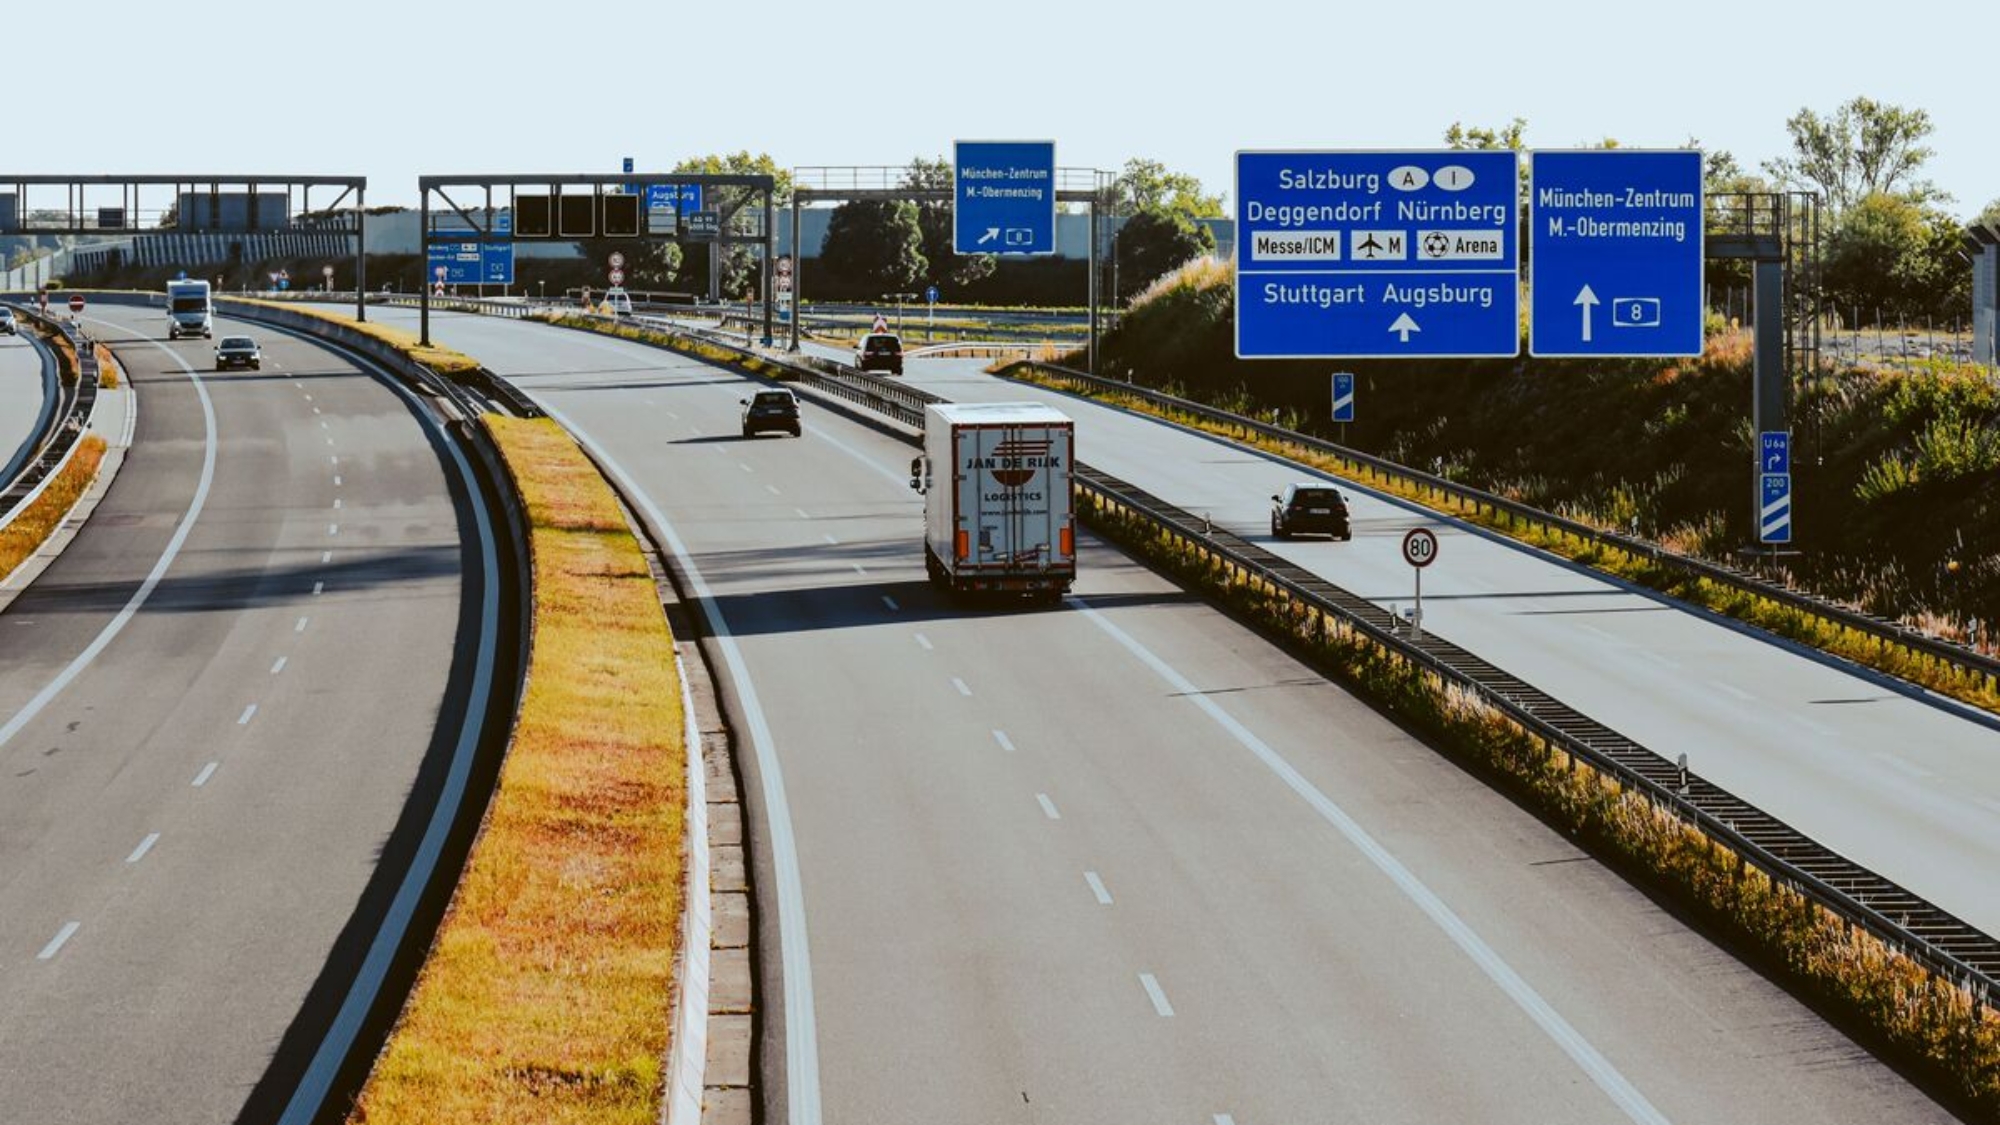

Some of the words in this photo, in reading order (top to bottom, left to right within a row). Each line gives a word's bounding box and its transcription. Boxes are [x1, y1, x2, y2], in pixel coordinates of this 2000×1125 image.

[961, 167, 1048, 179] München-Zentrum
[1279, 169, 1380, 194] Salzburg
[1402, 171, 1415, 186] A
[1451, 171, 1456, 186] I
[1539, 187, 1694, 208] München-Zentrum
[1247, 201, 1382, 226] Deggendorf
[1397, 200, 1506, 226] Nürnberg
[1548, 216, 1686, 242] M.-Obermenzing
[1257, 236, 1335, 255] Messe/ICM
[1389, 237, 1401, 254] M
[1455, 237, 1498, 254] Arena
[1263, 283, 1365, 308] Stuttgart
[1382, 283, 1493, 308] Augsburg
[1630, 303, 1642, 321] 8
[966, 457, 996, 469] JAN
[1002, 457, 1022, 469] DE
[1027, 456, 1060, 468] RIJK
[1766, 478, 1785, 487] 200
[984, 492, 1042, 502] LOGISTICS
[1410, 538, 1431, 557] 80
